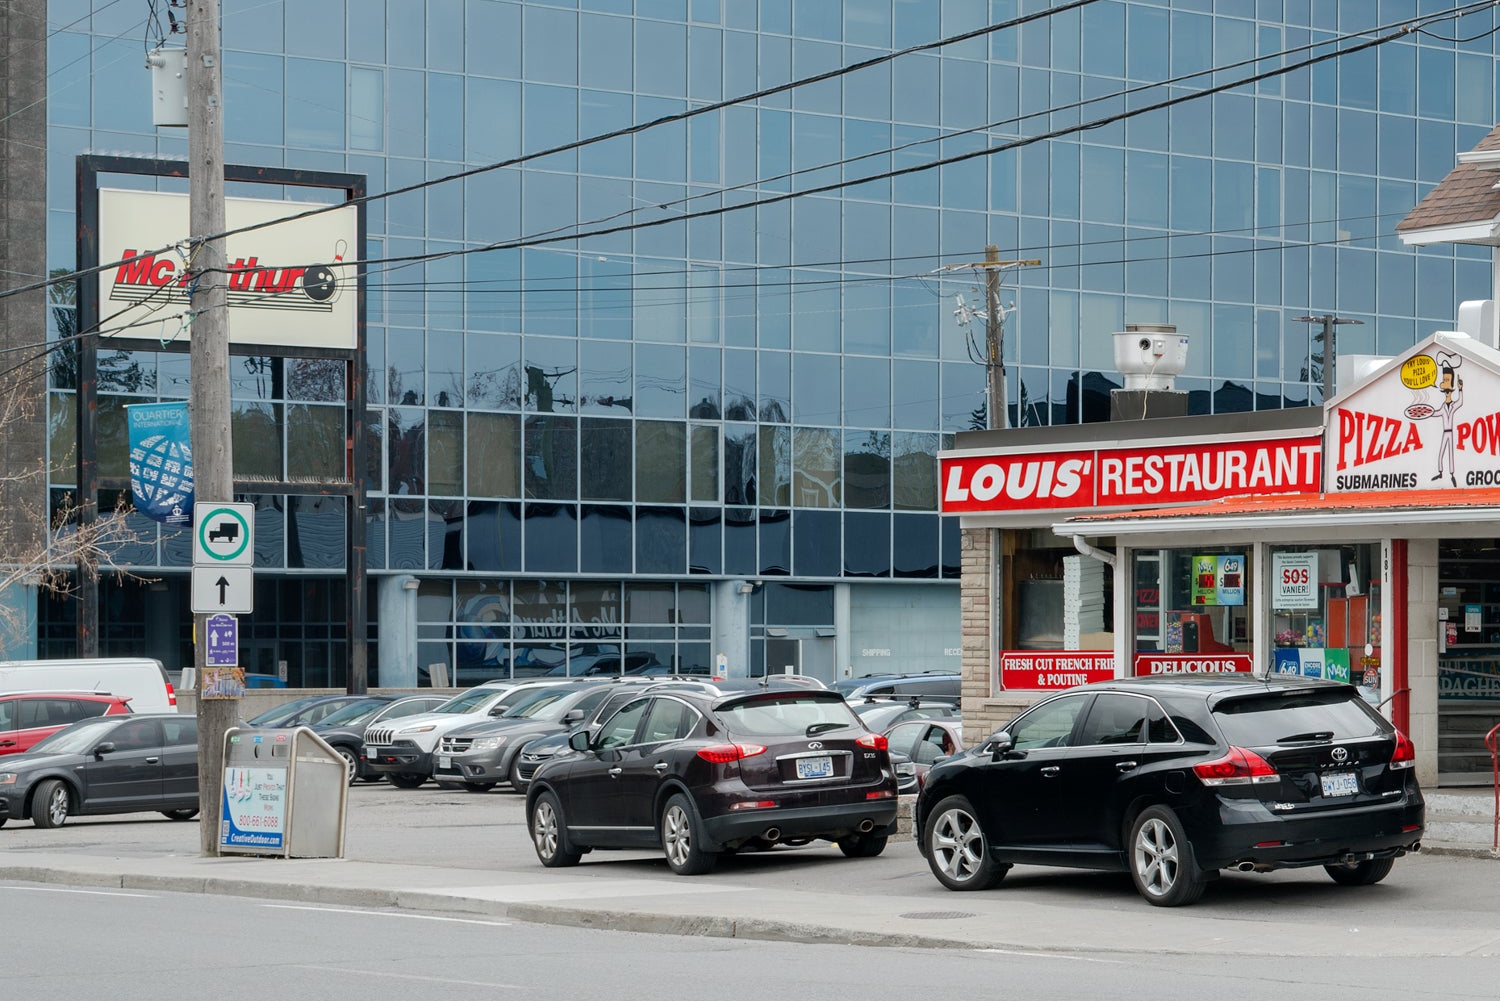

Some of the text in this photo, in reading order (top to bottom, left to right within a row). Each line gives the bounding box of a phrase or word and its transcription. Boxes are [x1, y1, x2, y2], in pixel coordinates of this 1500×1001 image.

[132, 408, 183, 422] QUARTIER
[1336, 407, 1423, 471] PIZZA
[944, 445, 1321, 502] LOUIS' RESTAURANT
[1336, 472, 1417, 490] SUBMARINES
[1283, 568, 1308, 584] SOS
[862, 648, 890, 656] SHIPPING
[1004, 658, 1034, 670] FRESH
[1035, 658, 1054, 670] CUT
[1056, 658, 1092, 670] FRENCH
[1150, 660, 1237, 674] DELICIOUS
[1038, 674, 1088, 686] & POUTINE
[231, 833, 280, 844] CreativeOutdoor.com
